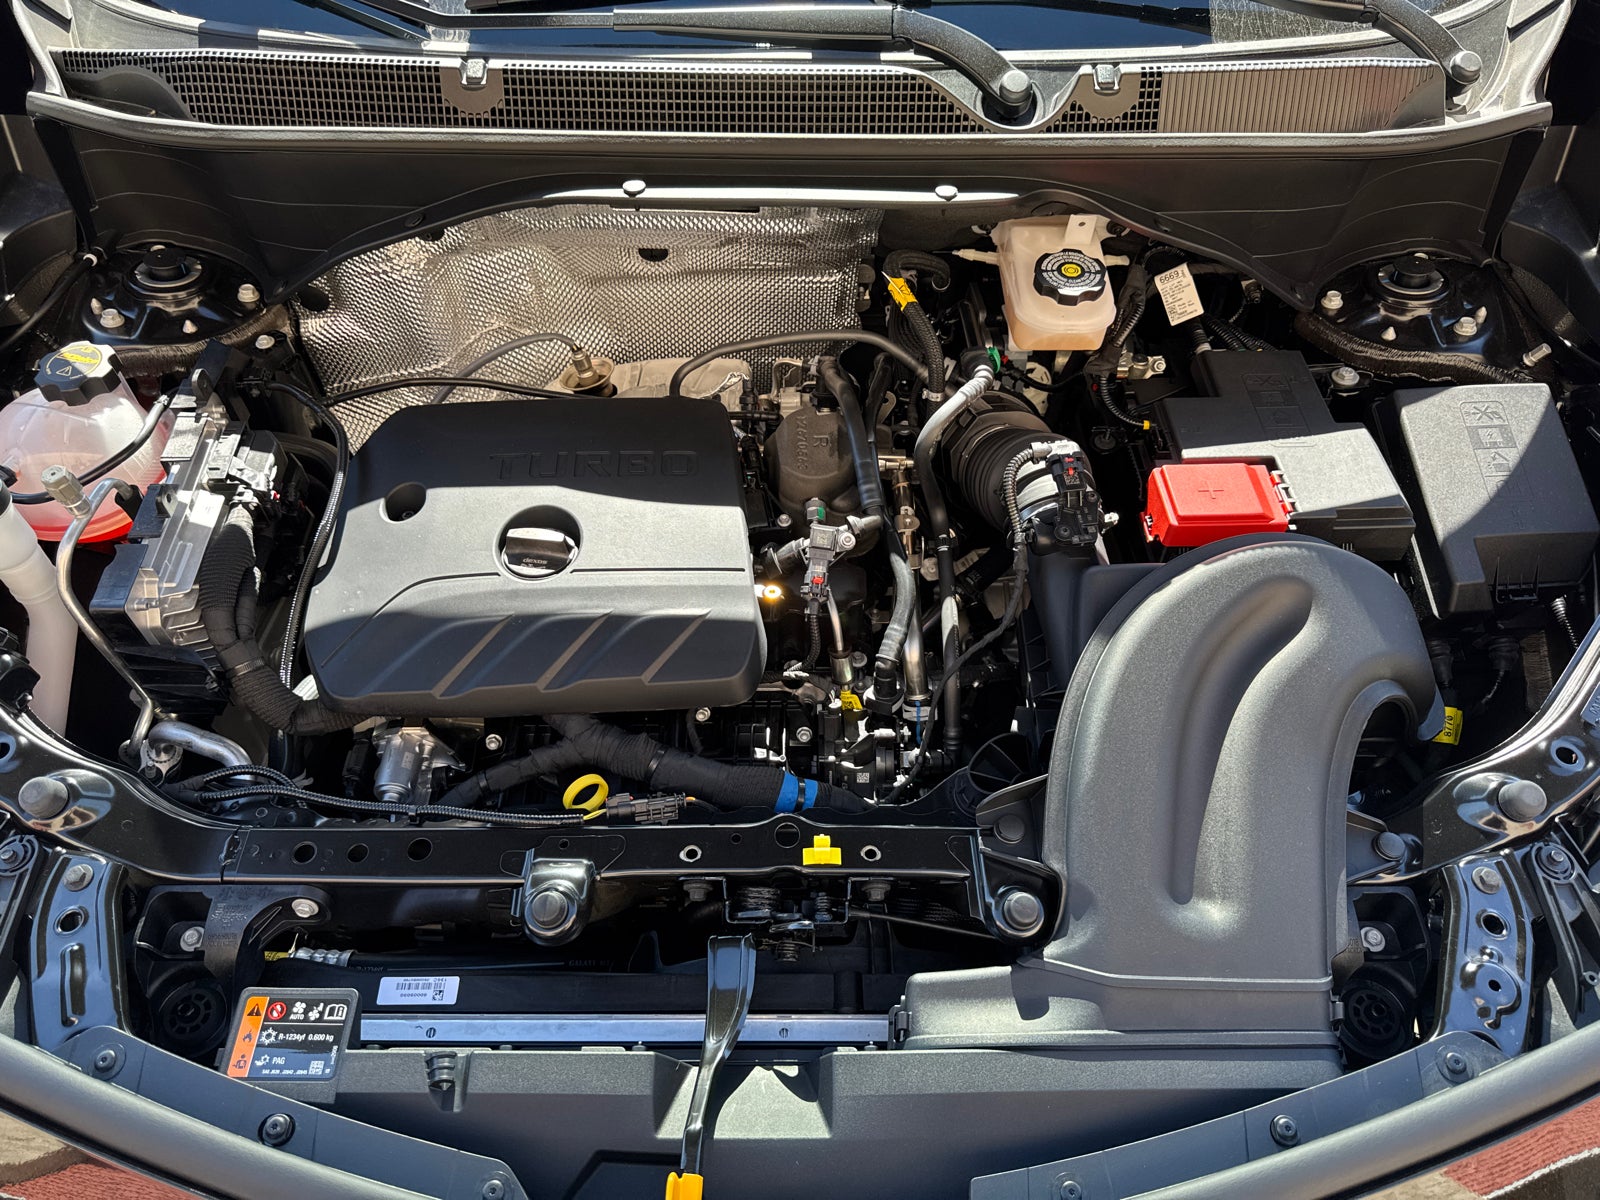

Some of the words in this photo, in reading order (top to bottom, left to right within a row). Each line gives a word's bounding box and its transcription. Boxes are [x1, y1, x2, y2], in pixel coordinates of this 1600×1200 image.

[1159, 270, 1180, 284] 6669
[489, 450, 700, 480] TURBO
[522, 557, 548, 565] dexos
[278, 1033, 305, 1042] R-1234yf
[308, 1033, 325, 1041] 0.600
[326, 1034, 334, 1042] kg
[272, 1056, 286, 1065] PAG
